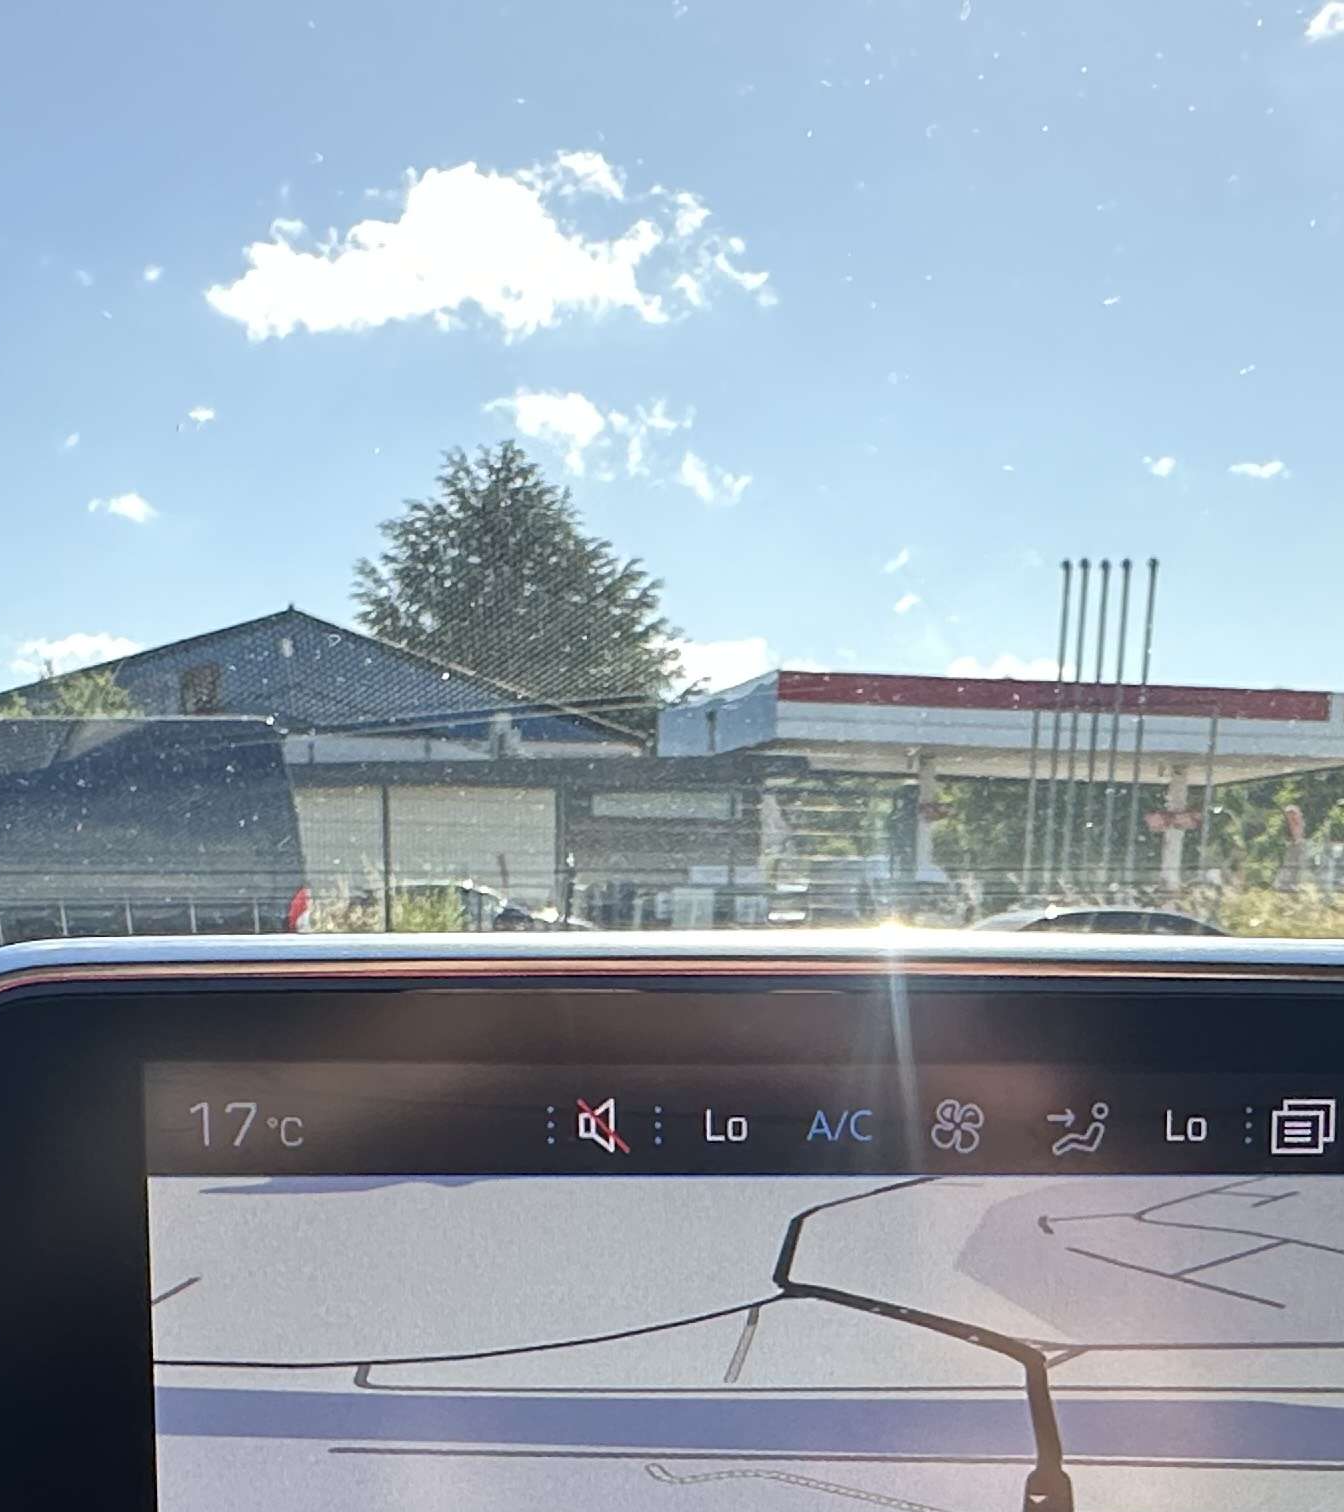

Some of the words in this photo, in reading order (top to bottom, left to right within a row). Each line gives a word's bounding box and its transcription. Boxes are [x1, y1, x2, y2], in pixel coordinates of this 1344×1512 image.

[189, 1101, 256, 1148] 17
[266, 1115, 304, 1148] °C
[704, 1108, 749, 1142] Lo
[806, 1108, 874, 1142] A/C
[1165, 1108, 1208, 1143] Lo
